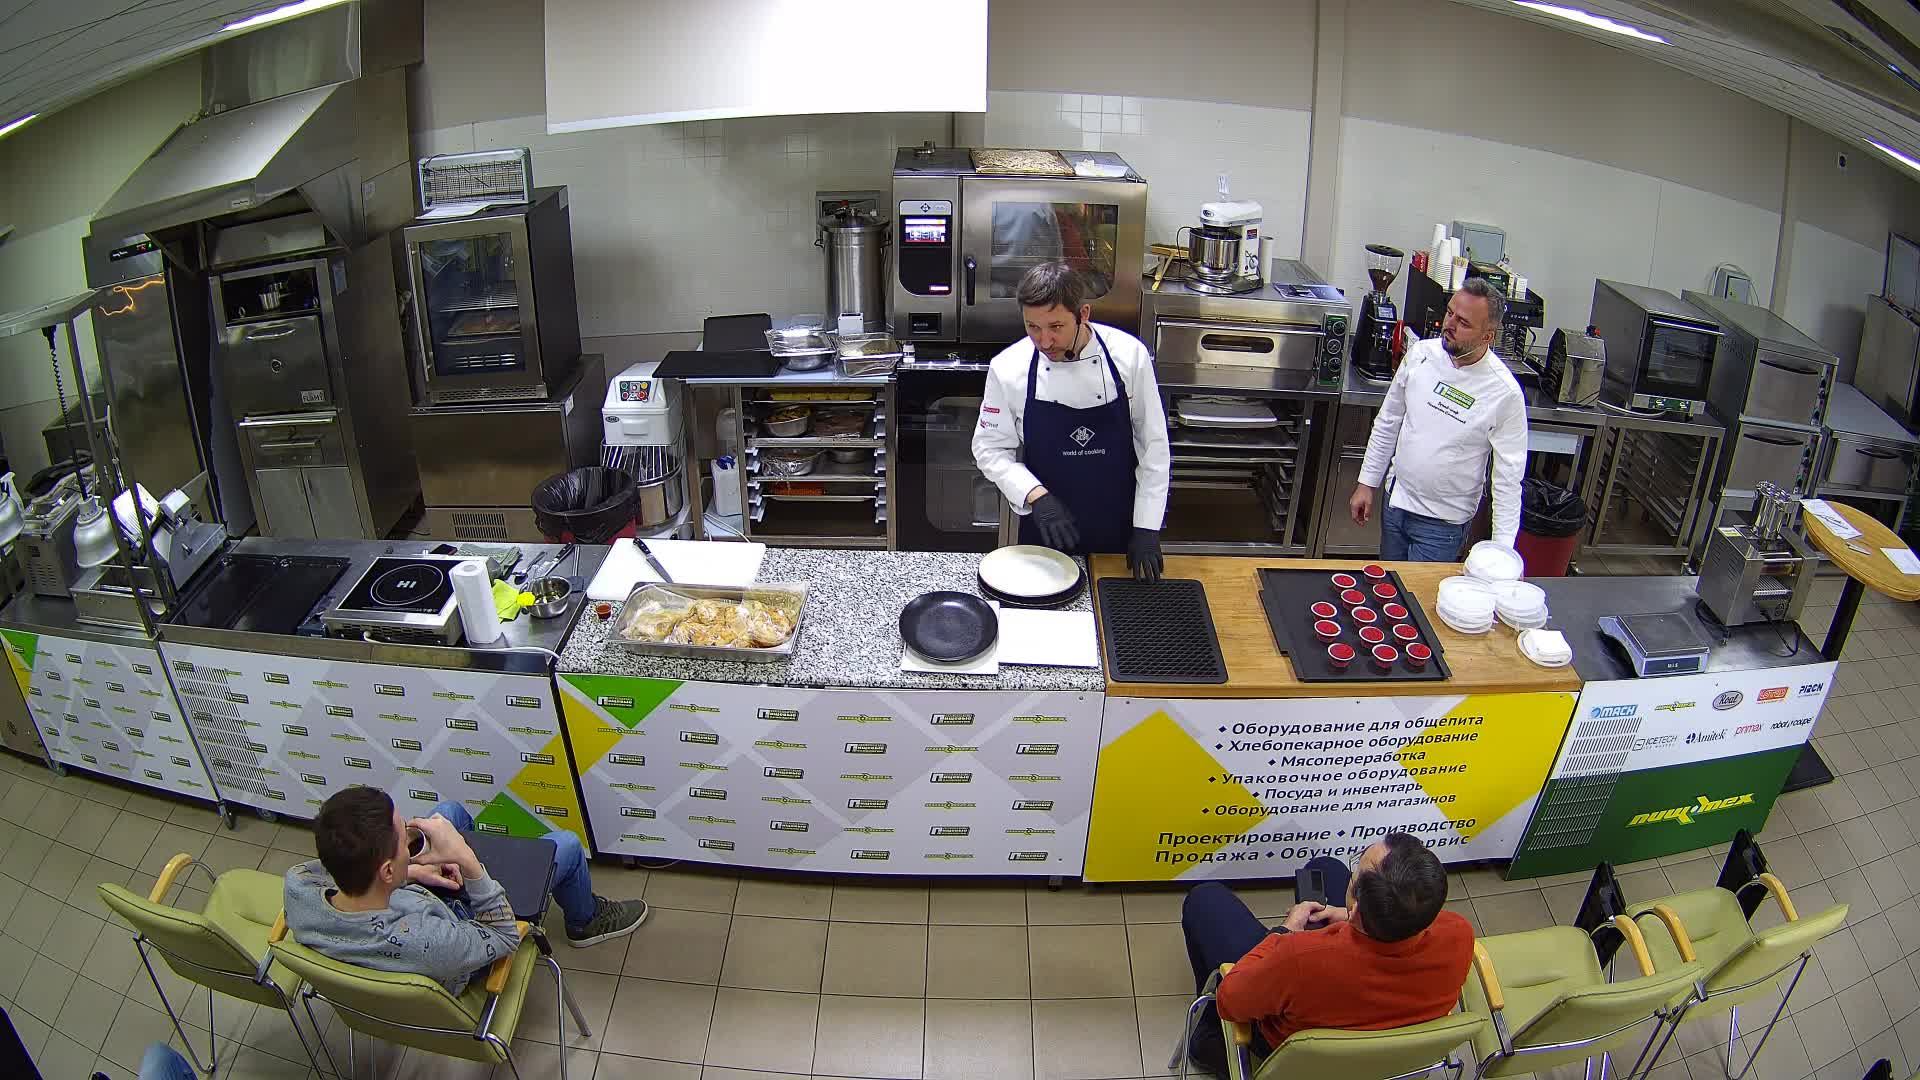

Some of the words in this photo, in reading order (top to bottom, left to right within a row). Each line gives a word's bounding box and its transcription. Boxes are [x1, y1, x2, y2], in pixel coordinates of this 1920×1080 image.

[1601, 705, 1637, 717] MACH
[1232, 721, 1365, 736] Оборудование
[1368, 719, 1400, 732] для
[1405, 714, 1484, 729] общепита
[1228, 738, 1364, 752] Хлебопекарное
[1368, 731, 1478, 748] оборудование
[1281, 750, 1426, 767] Мясопереработка
[1222, 770, 1342, 784] Упаковочное
[1348, 763, 1467, 782] оборудование
[1264, 788, 1323, 801] Посуда
[1327, 787, 1337, 796] и
[1342, 782, 1422, 796] инвентарь
[1214, 801, 1339, 817] Оборудование
[1342, 800, 1373, 812] для
[1376, 793, 1456, 809] магазинов
[1157, 829, 1331, 846] Проектирование
[1350, 817, 1476, 839] Производство
[1155, 849, 1259, 864] Продажа
